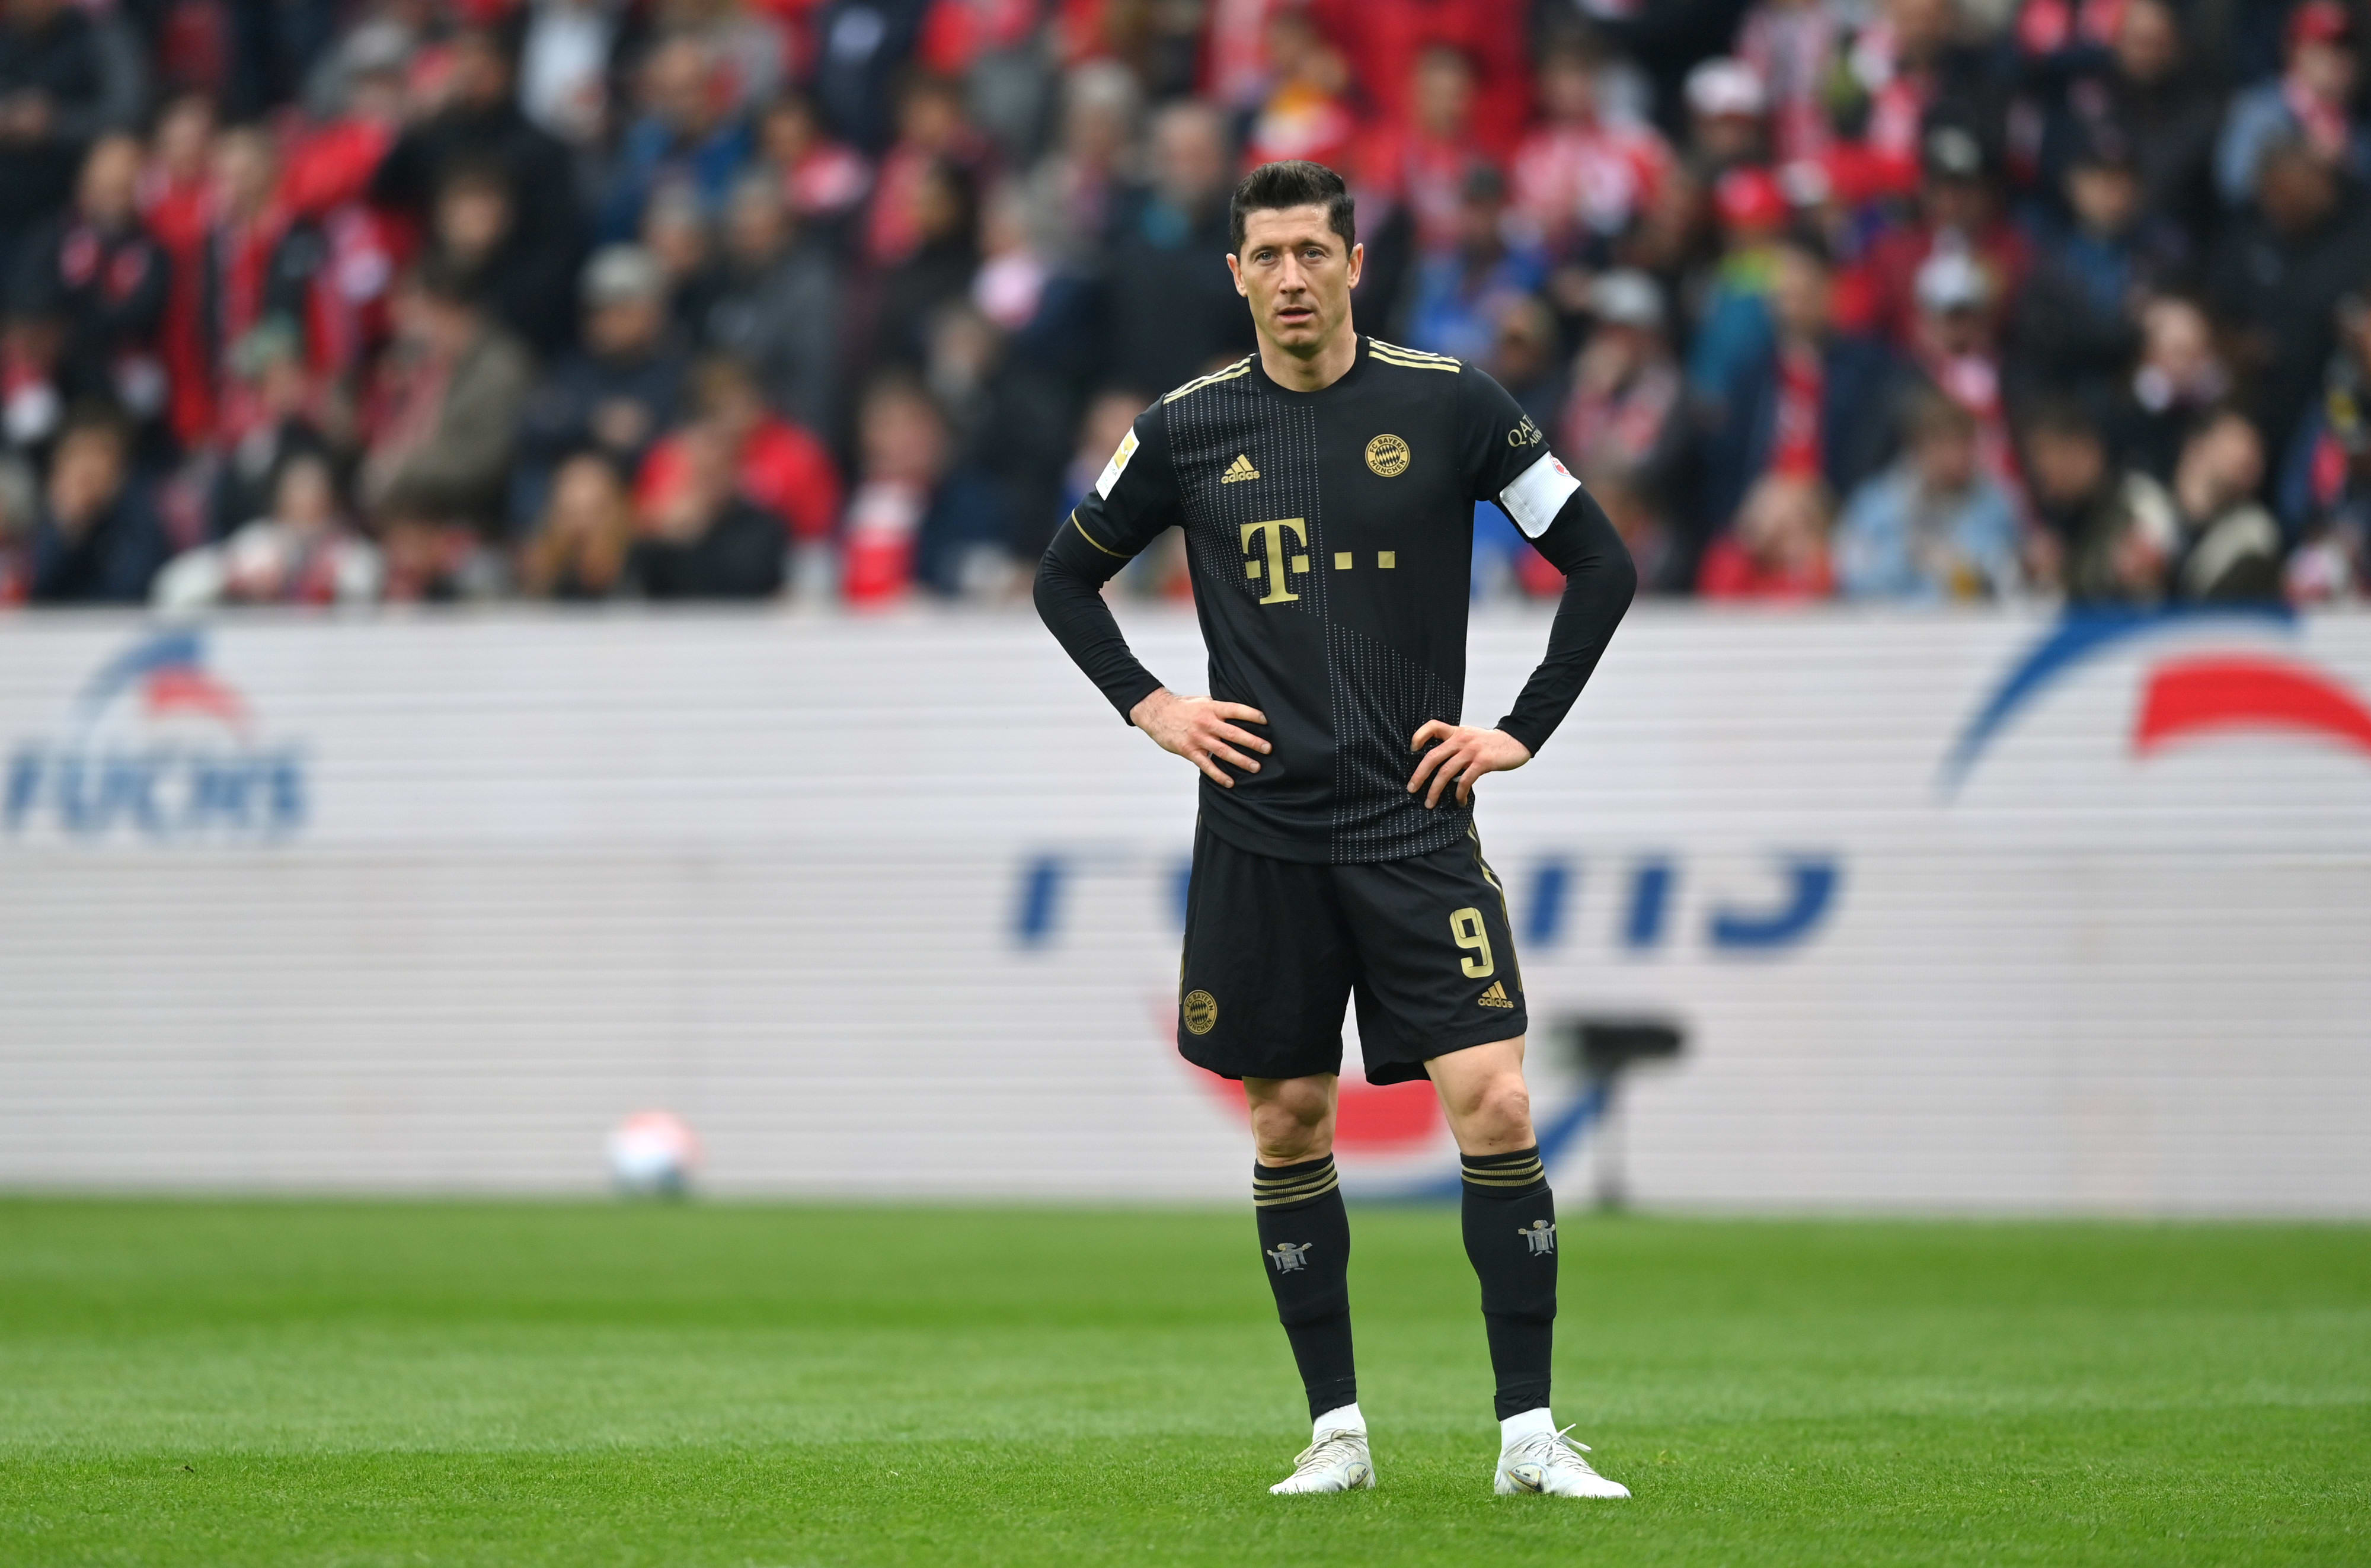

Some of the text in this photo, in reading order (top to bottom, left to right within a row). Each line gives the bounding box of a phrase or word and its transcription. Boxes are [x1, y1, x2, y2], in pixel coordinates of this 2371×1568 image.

[1508, 414, 1535, 447] QAT
[1370, 438, 1405, 453] FC BAYERN
[1221, 470, 1260, 484] adidas
[1449, 907, 1494, 978] 9
[1186, 994, 1214, 1011] FC BAYERN
[1478, 996, 1513, 1008] adidas
